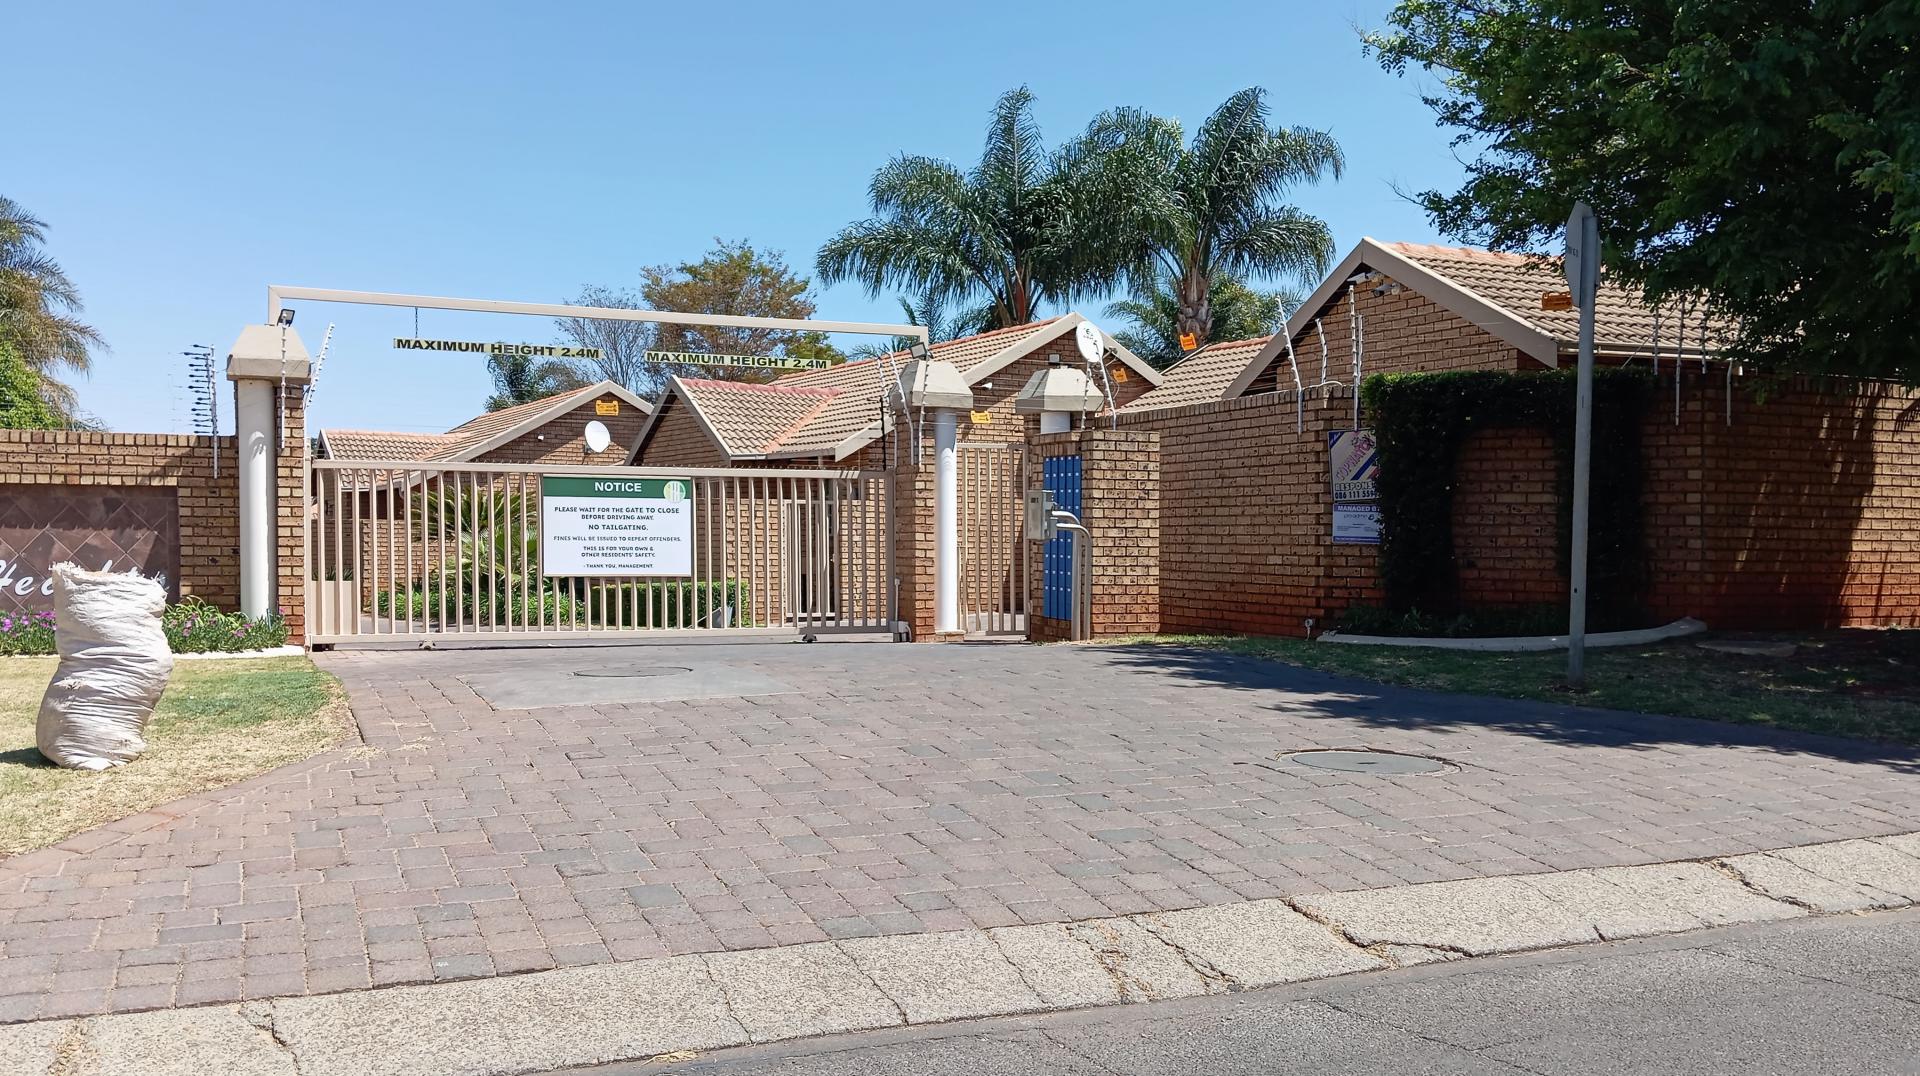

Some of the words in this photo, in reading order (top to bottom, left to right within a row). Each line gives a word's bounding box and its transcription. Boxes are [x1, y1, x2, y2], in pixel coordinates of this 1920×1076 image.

[396, 338, 485, 353] MAXIMUM
[491, 344, 555, 356] HEIGHT
[561, 347, 599, 358] 2.4M
[646, 352, 725, 364] MAXIMUM
[730, 357, 788, 367] HEIGHT
[793, 359, 827, 369] 2.4M
[594, 482, 642, 492] NOTICE
[1335, 482, 1375, 491] RESPONS
[1349, 490, 1360, 498] 111
